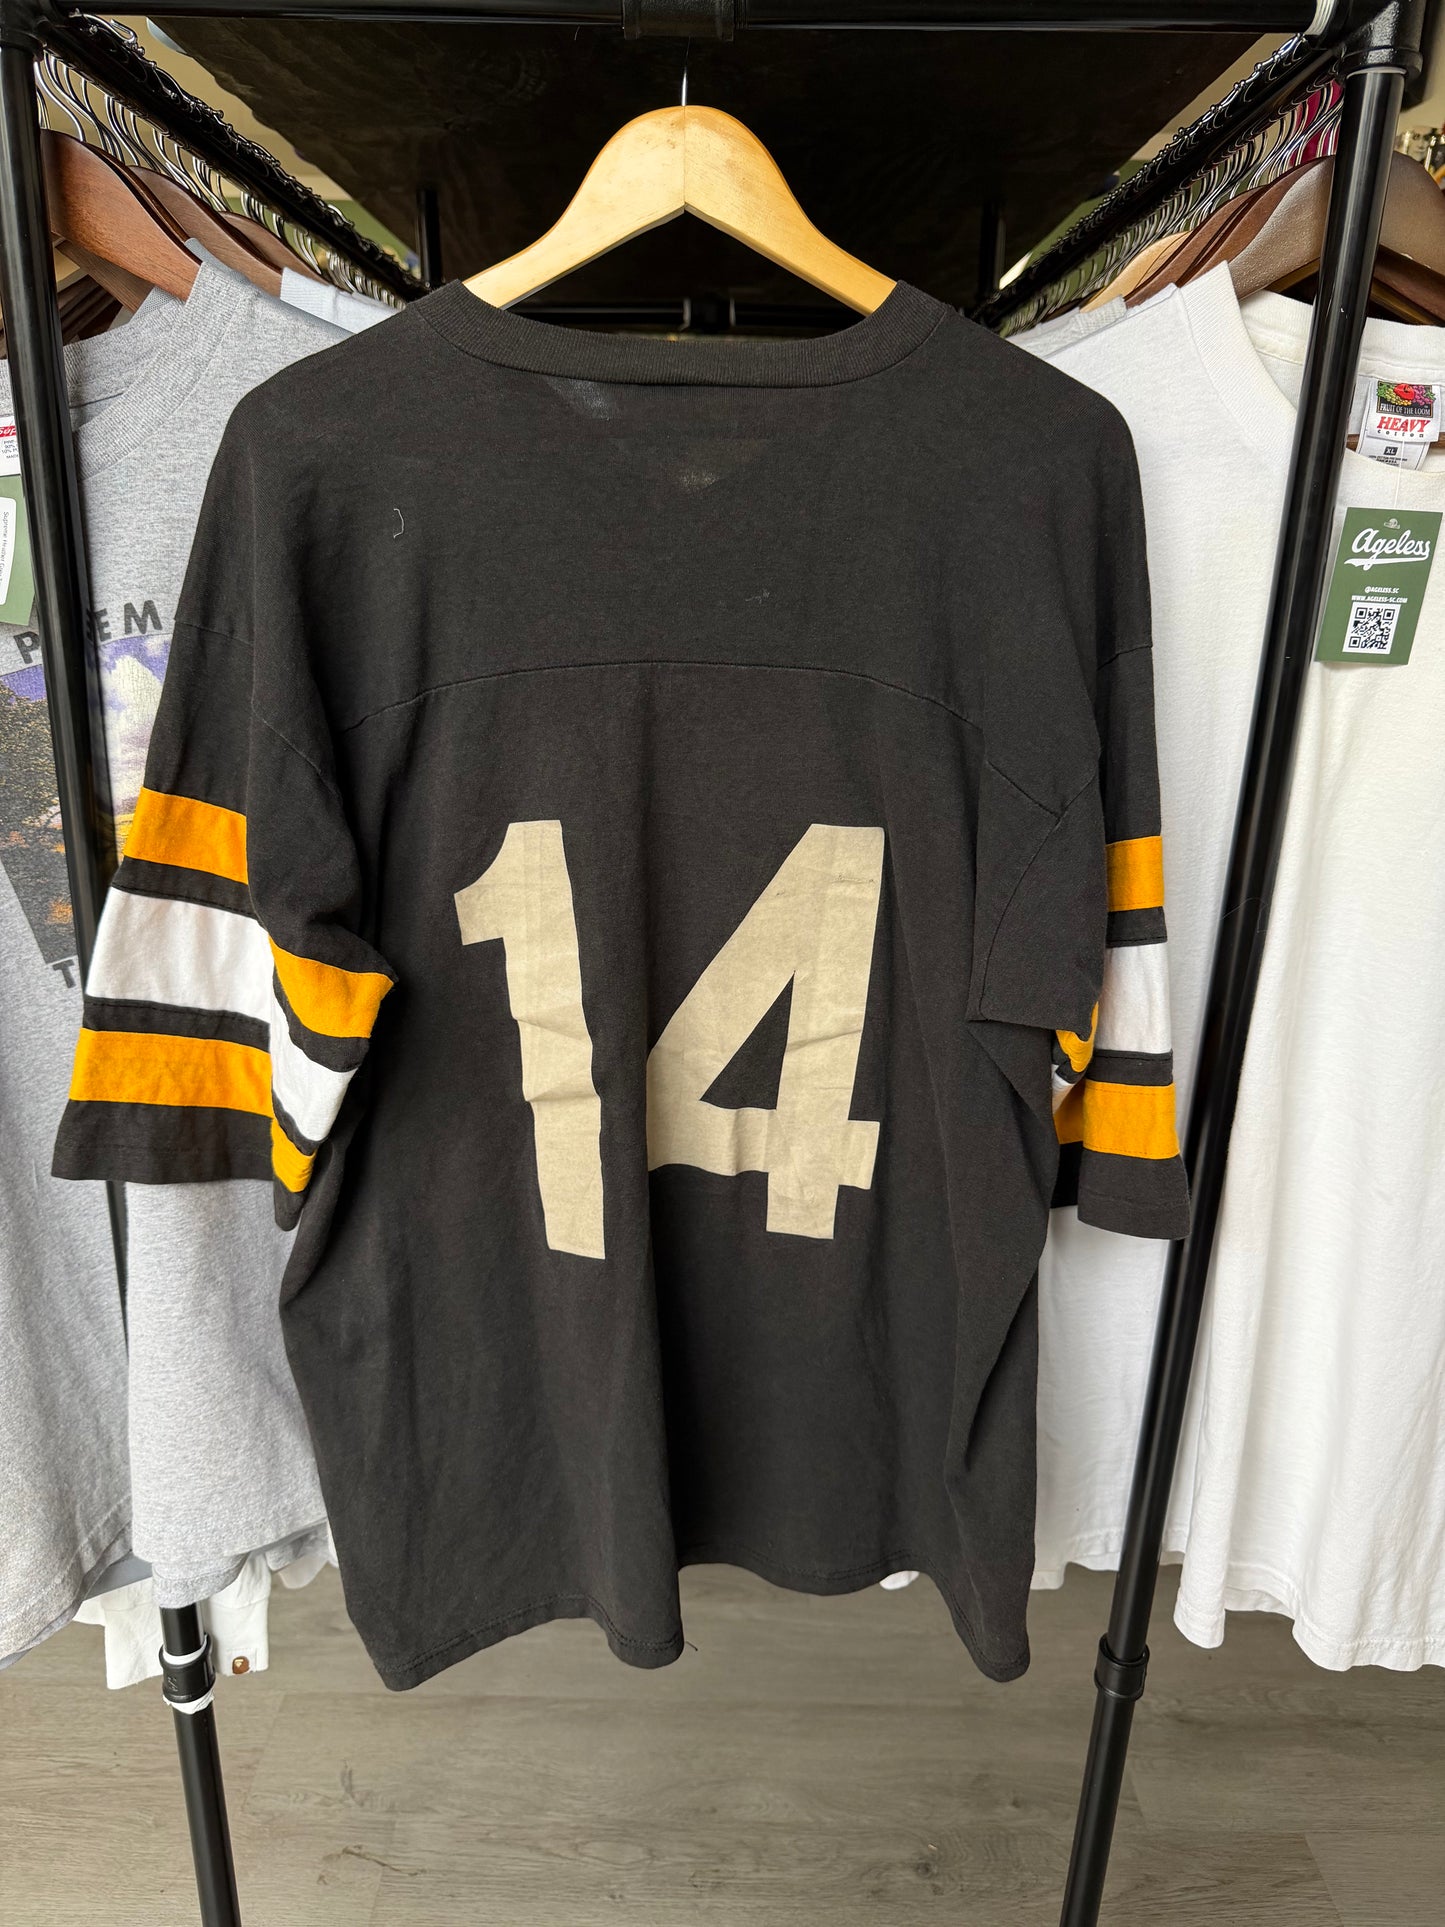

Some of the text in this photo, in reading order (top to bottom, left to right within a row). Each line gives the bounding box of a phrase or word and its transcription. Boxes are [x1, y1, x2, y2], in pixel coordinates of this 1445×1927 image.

[1380, 403, 1396, 412] FRUIT
[1396, 405, 1403, 413] OF
[1403, 406, 1415, 415] THE
[1414, 407, 1430, 416] LOOM
[1376, 416, 1431, 433] HEAVY
[1347, 528, 1431, 571] Ageless
[1364, 585, 1400, 594] @AGELESS.SC
[454, 819, 885, 1260] 14
